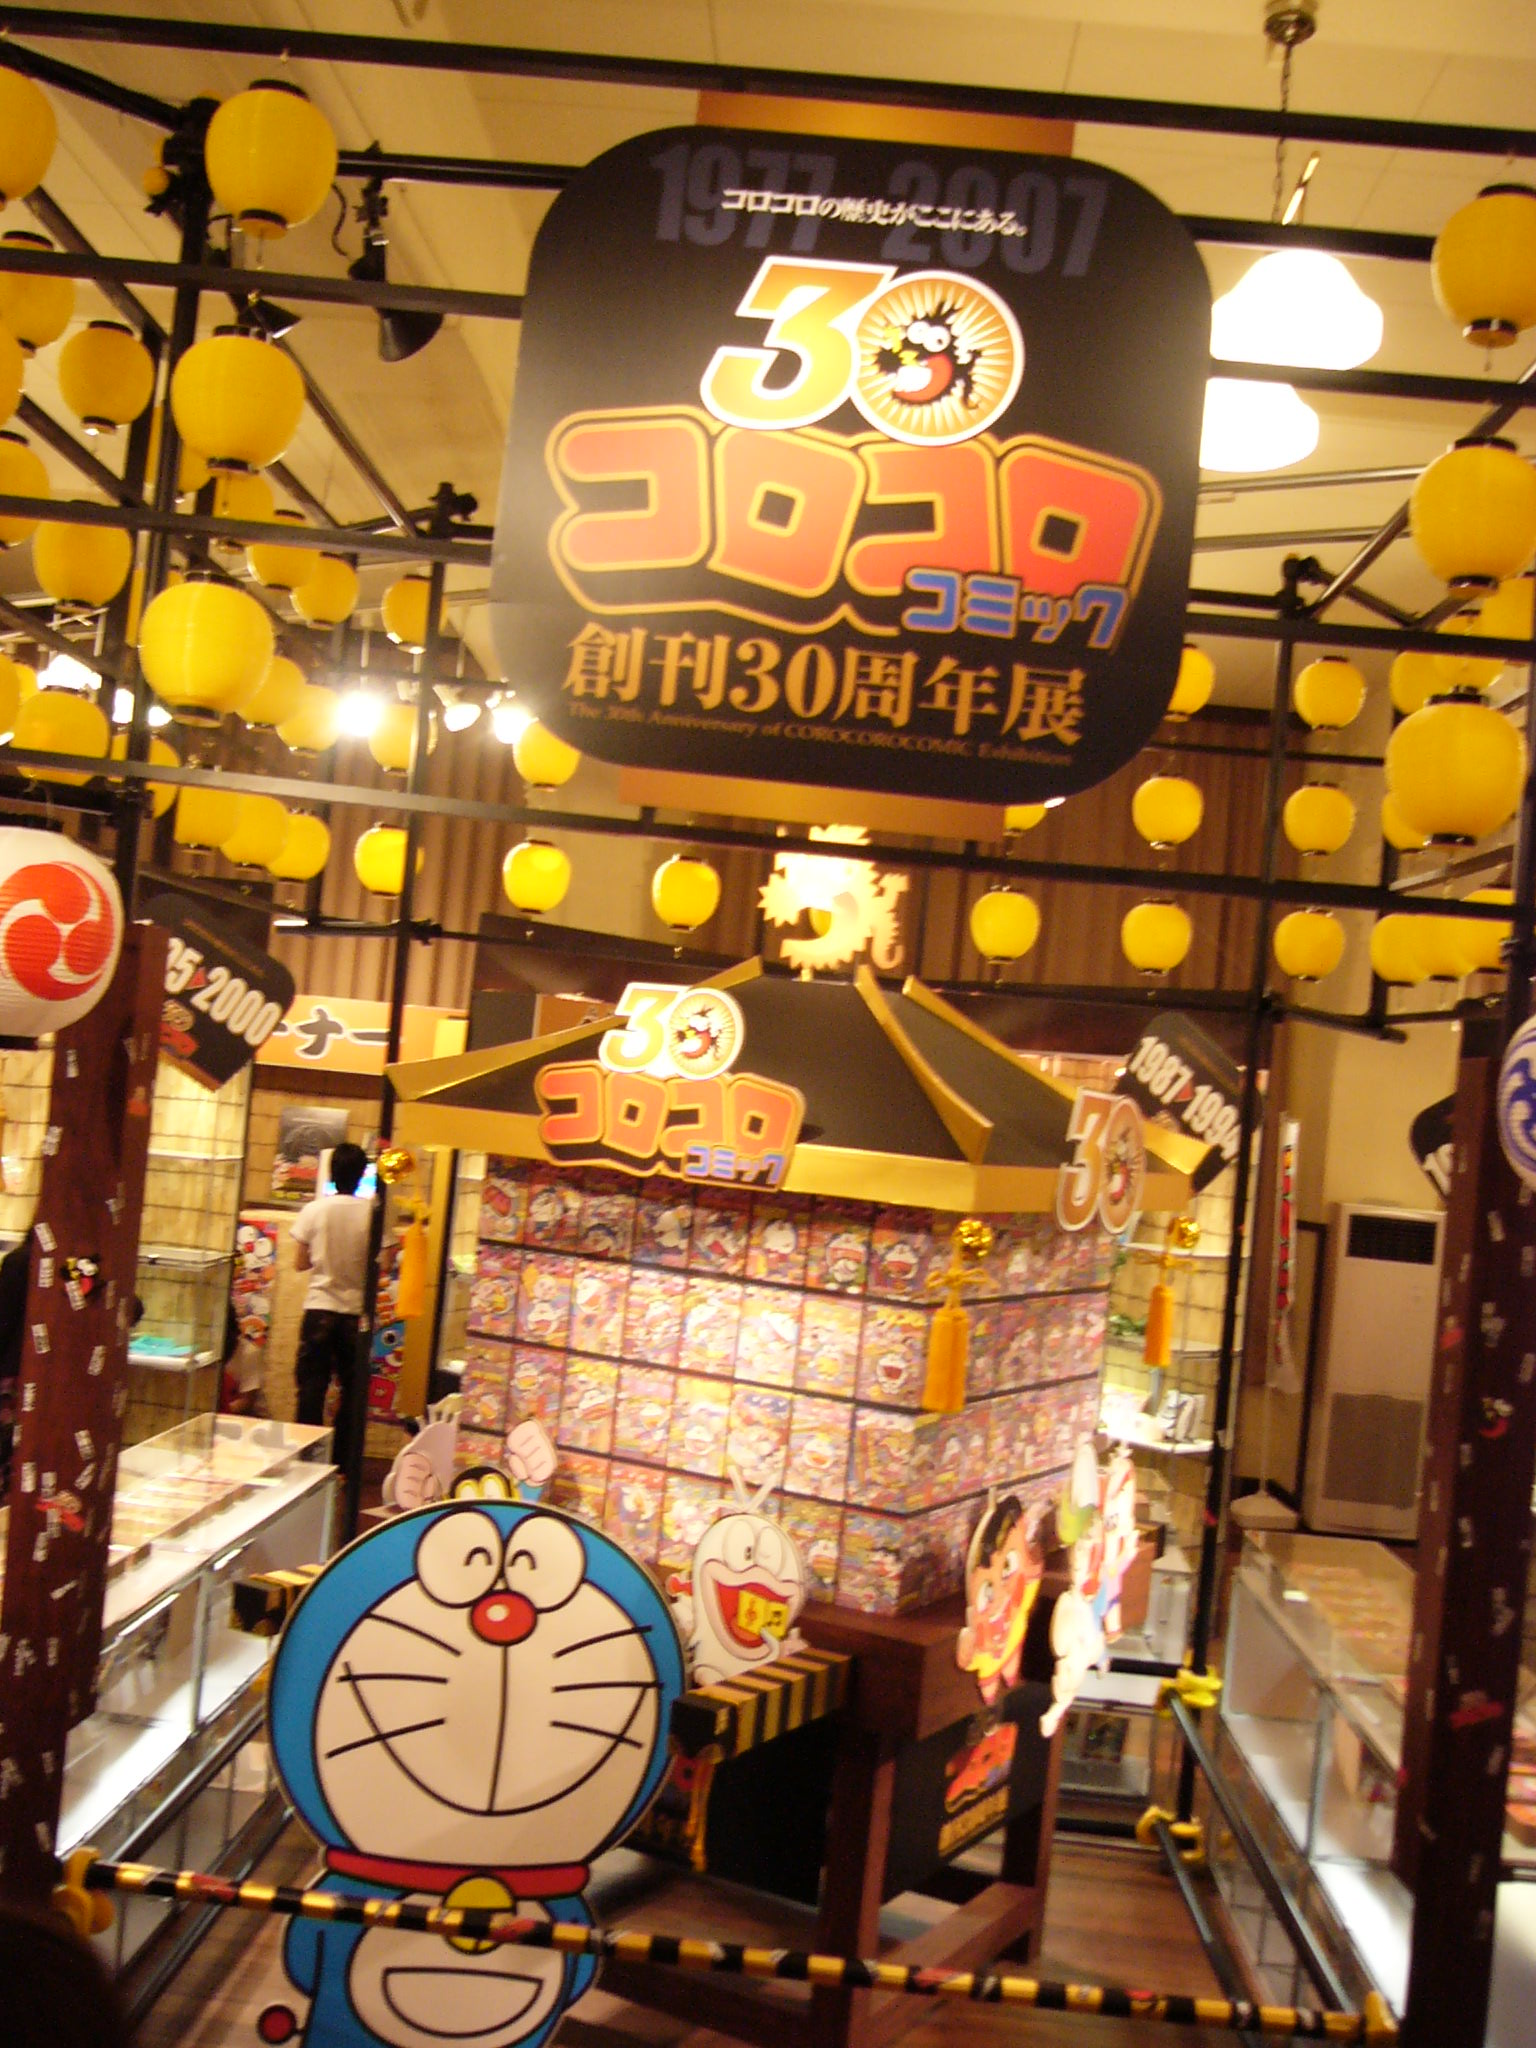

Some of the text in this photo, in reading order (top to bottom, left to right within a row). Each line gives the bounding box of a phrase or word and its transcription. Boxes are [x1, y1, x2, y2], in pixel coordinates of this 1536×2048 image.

[648, 144, 1110, 278] 1977 2007
[699, 255, 1026, 447] 30
[546, 406, 1162, 628] コロコロ
[903, 566, 1132, 648] コミック
[561, 620, 1088, 748] 創刊30周年展
[189, 965, 283, 1047] 2000
[536, 1060, 804, 1170] コロコロ
[1128, 1035, 1196, 1105] 1987
[682, 1143, 786, 1186] コミック
